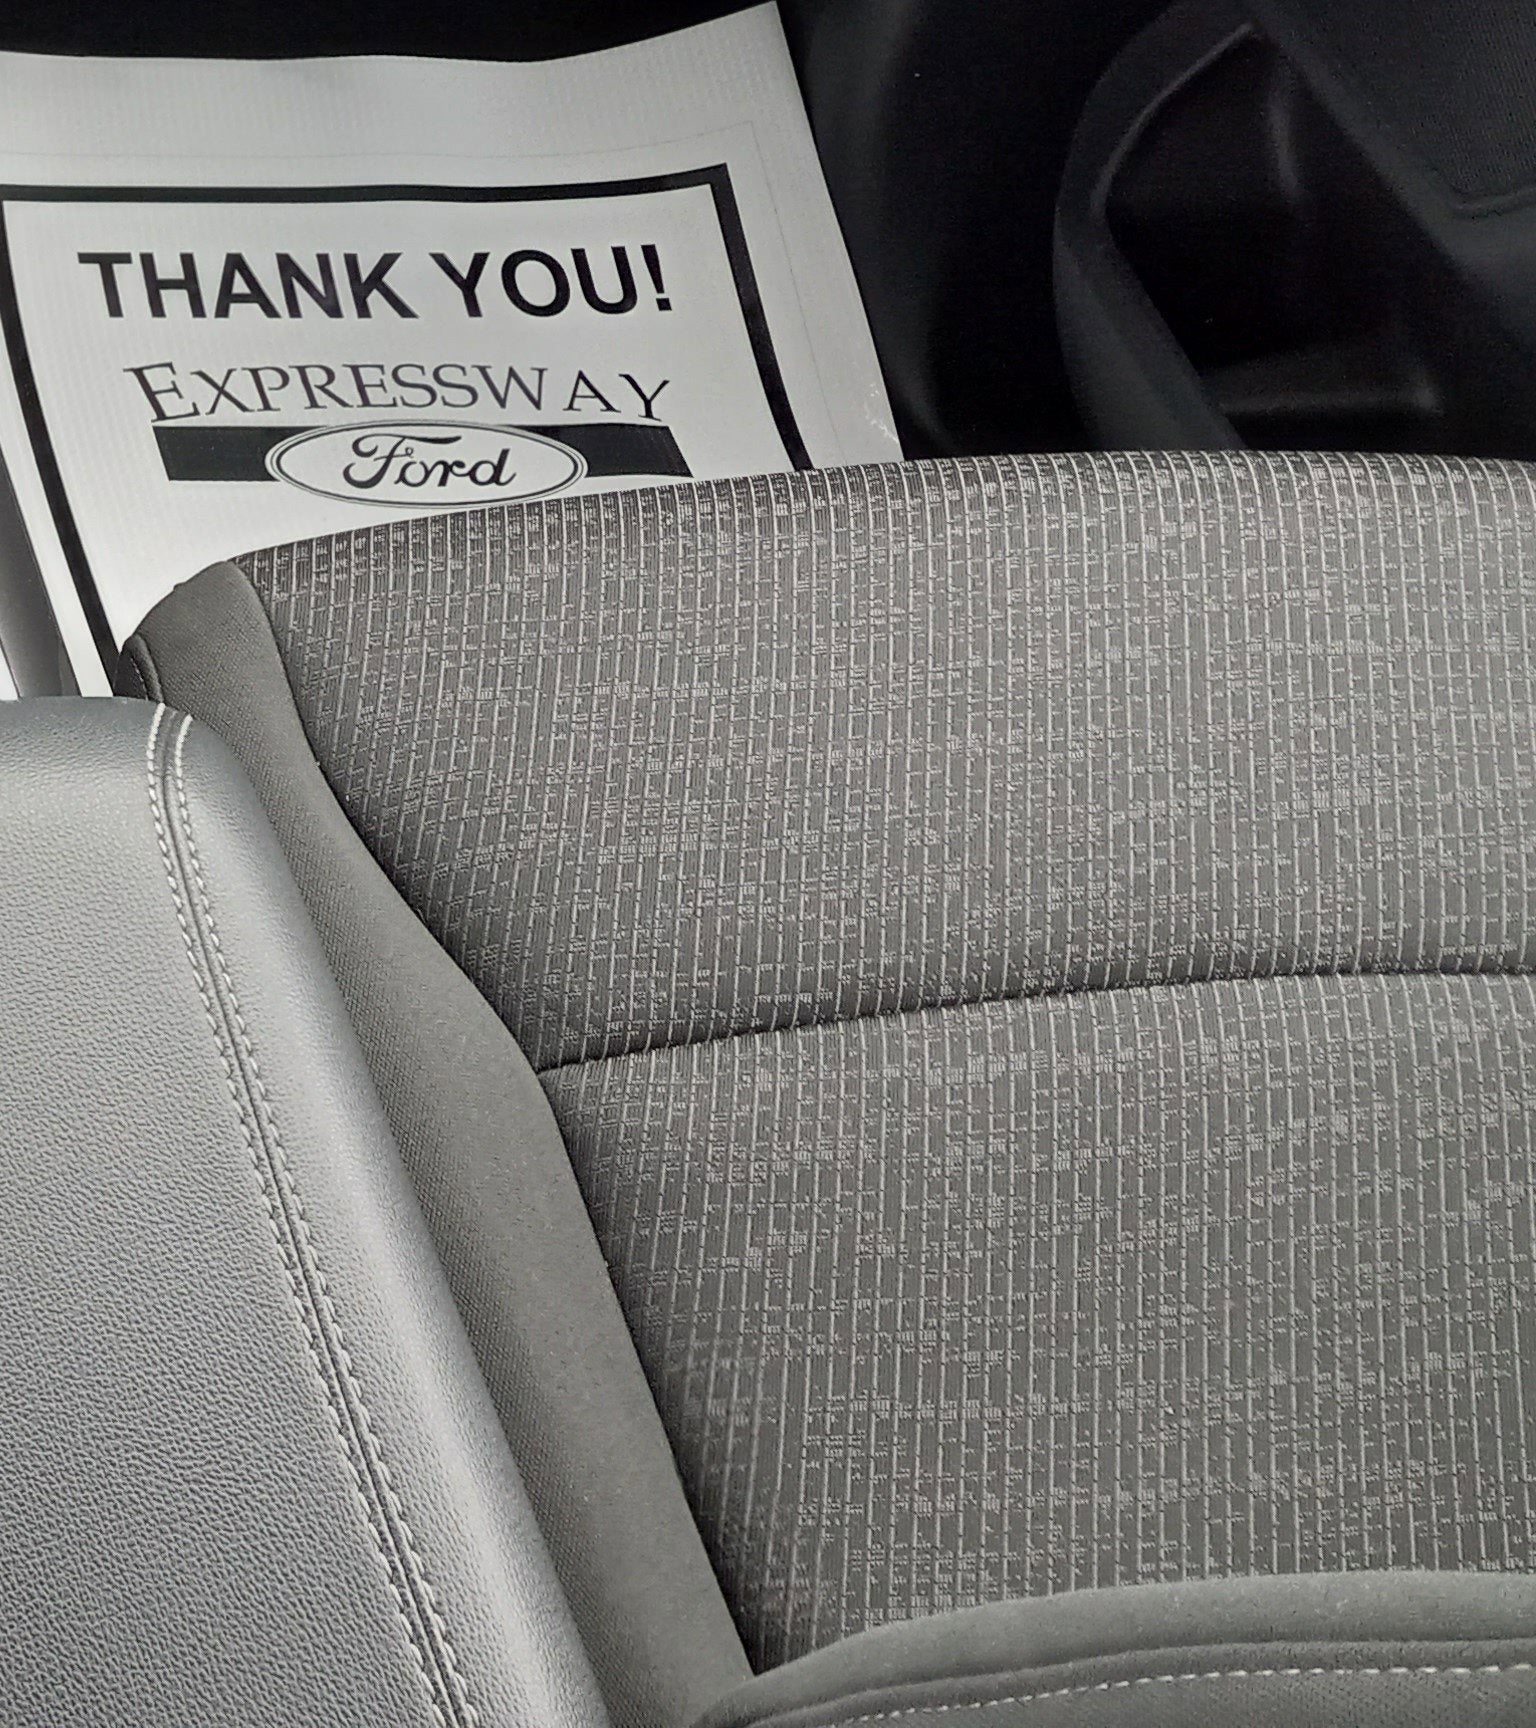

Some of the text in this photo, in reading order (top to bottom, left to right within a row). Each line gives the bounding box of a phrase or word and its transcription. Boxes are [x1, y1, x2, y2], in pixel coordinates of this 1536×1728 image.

[76, 242, 673, 320] THANK YOU!
[342, 432, 518, 490] Ford
